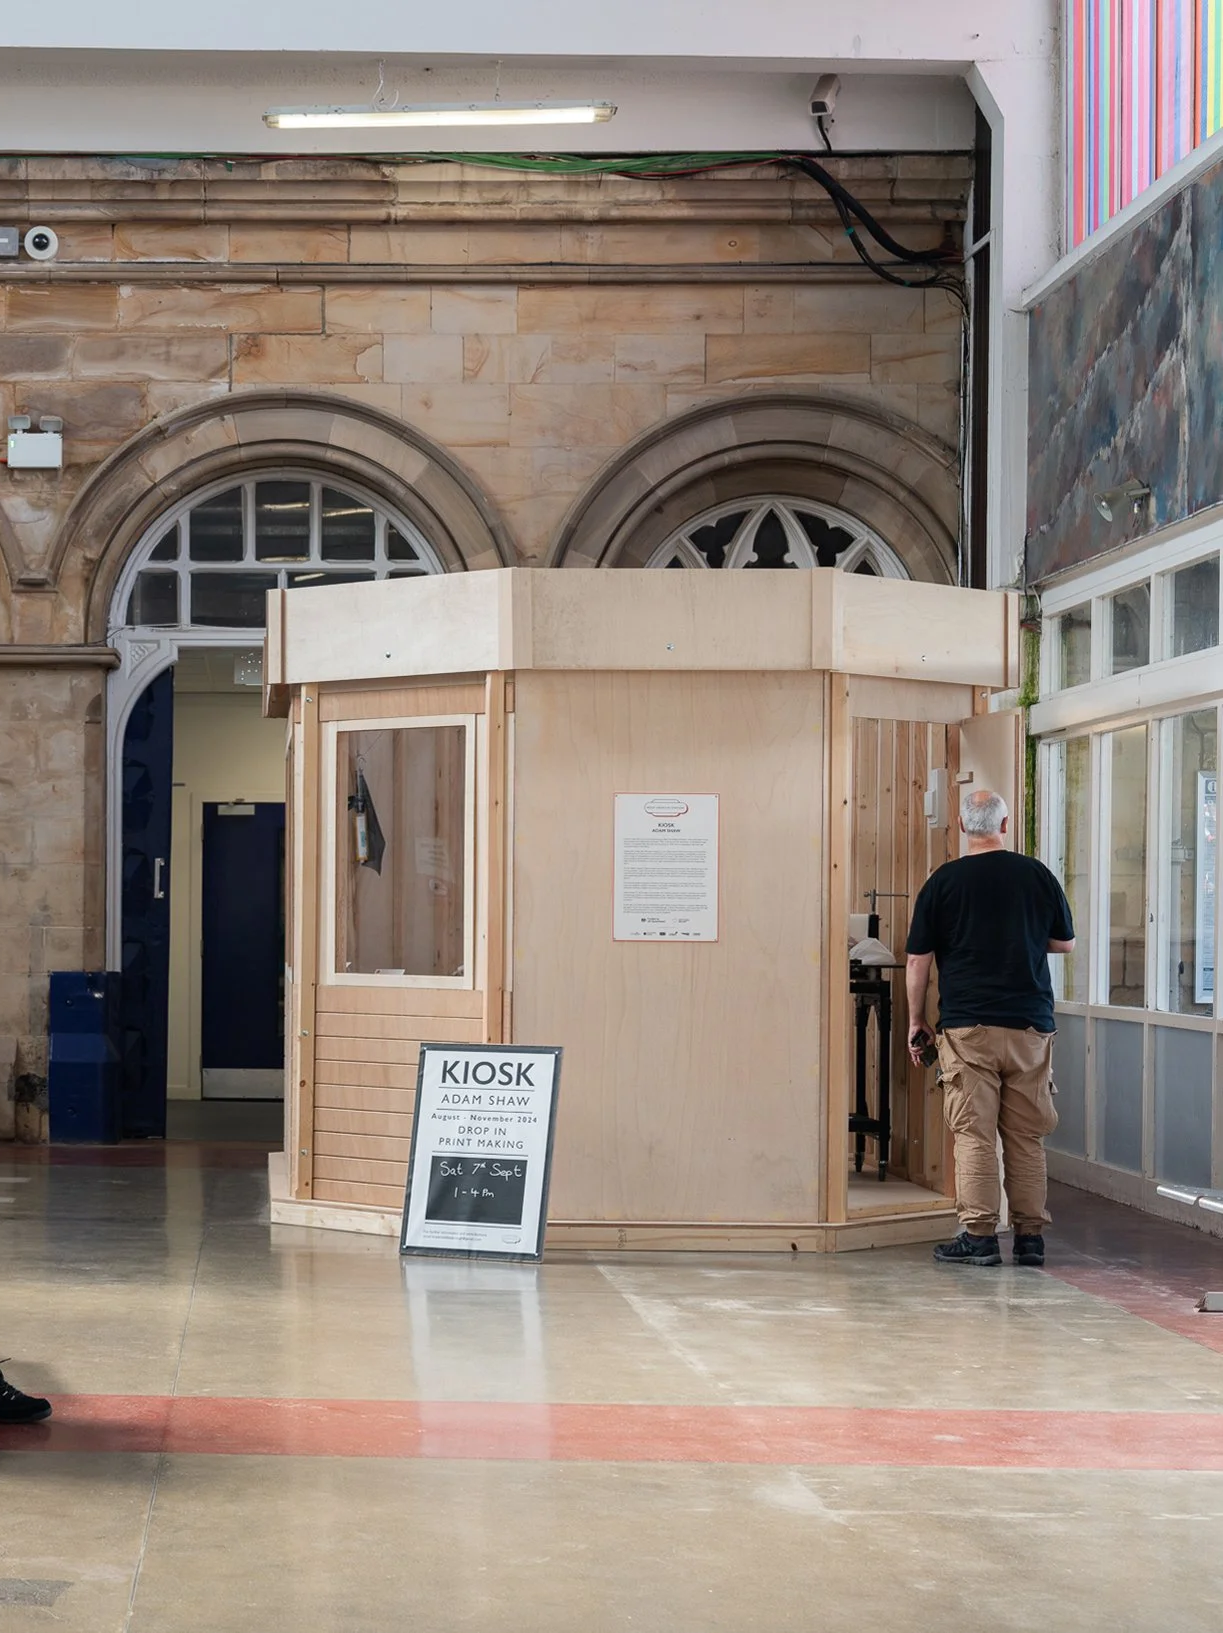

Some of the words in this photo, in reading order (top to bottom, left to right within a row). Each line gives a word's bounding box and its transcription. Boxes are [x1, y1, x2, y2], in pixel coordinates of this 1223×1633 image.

[441, 1060, 535, 1087] KIOSK
[441, 1094, 482, 1105] ADAM
[488, 1095, 530, 1106] SHAW
[431, 1113, 460, 1122] August
[470, 1114, 514, 1123] November
[517, 1116, 537, 1124] 2024
[458, 1126, 489, 1136] DROP
[494, 1127, 507, 1136] IN
[438, 1137, 472, 1147] PRINT
[477, 1139, 524, 1150] MAKING
[440, 1161, 463, 1177] Sat
[489, 1163, 522, 1181] Sept
